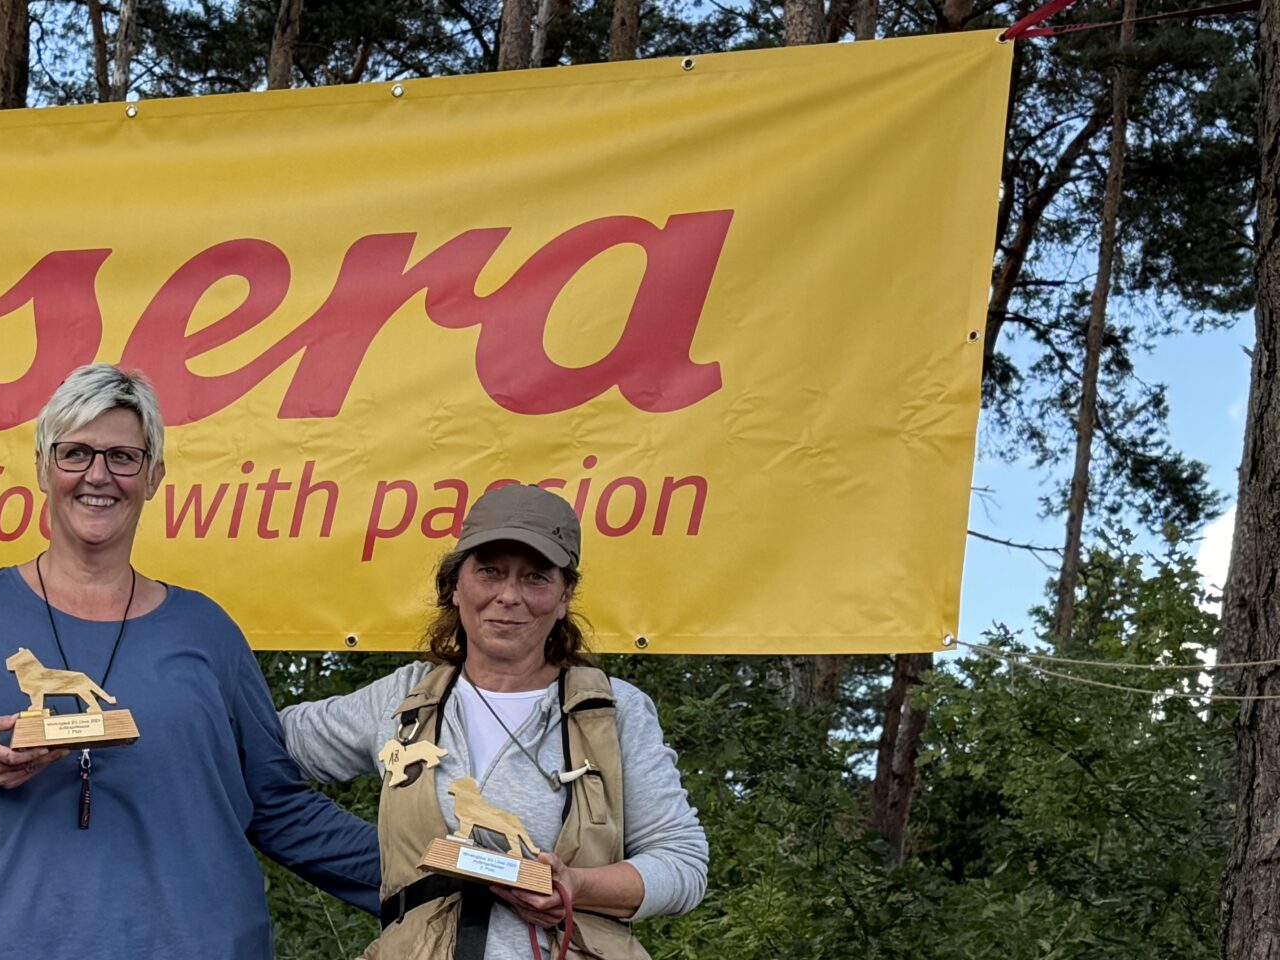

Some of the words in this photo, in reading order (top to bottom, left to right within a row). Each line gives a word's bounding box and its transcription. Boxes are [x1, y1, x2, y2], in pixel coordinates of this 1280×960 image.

[163, 459, 340, 540] with
[360, 454, 709, 563] paion
[388, 749, 400, 766] 18
